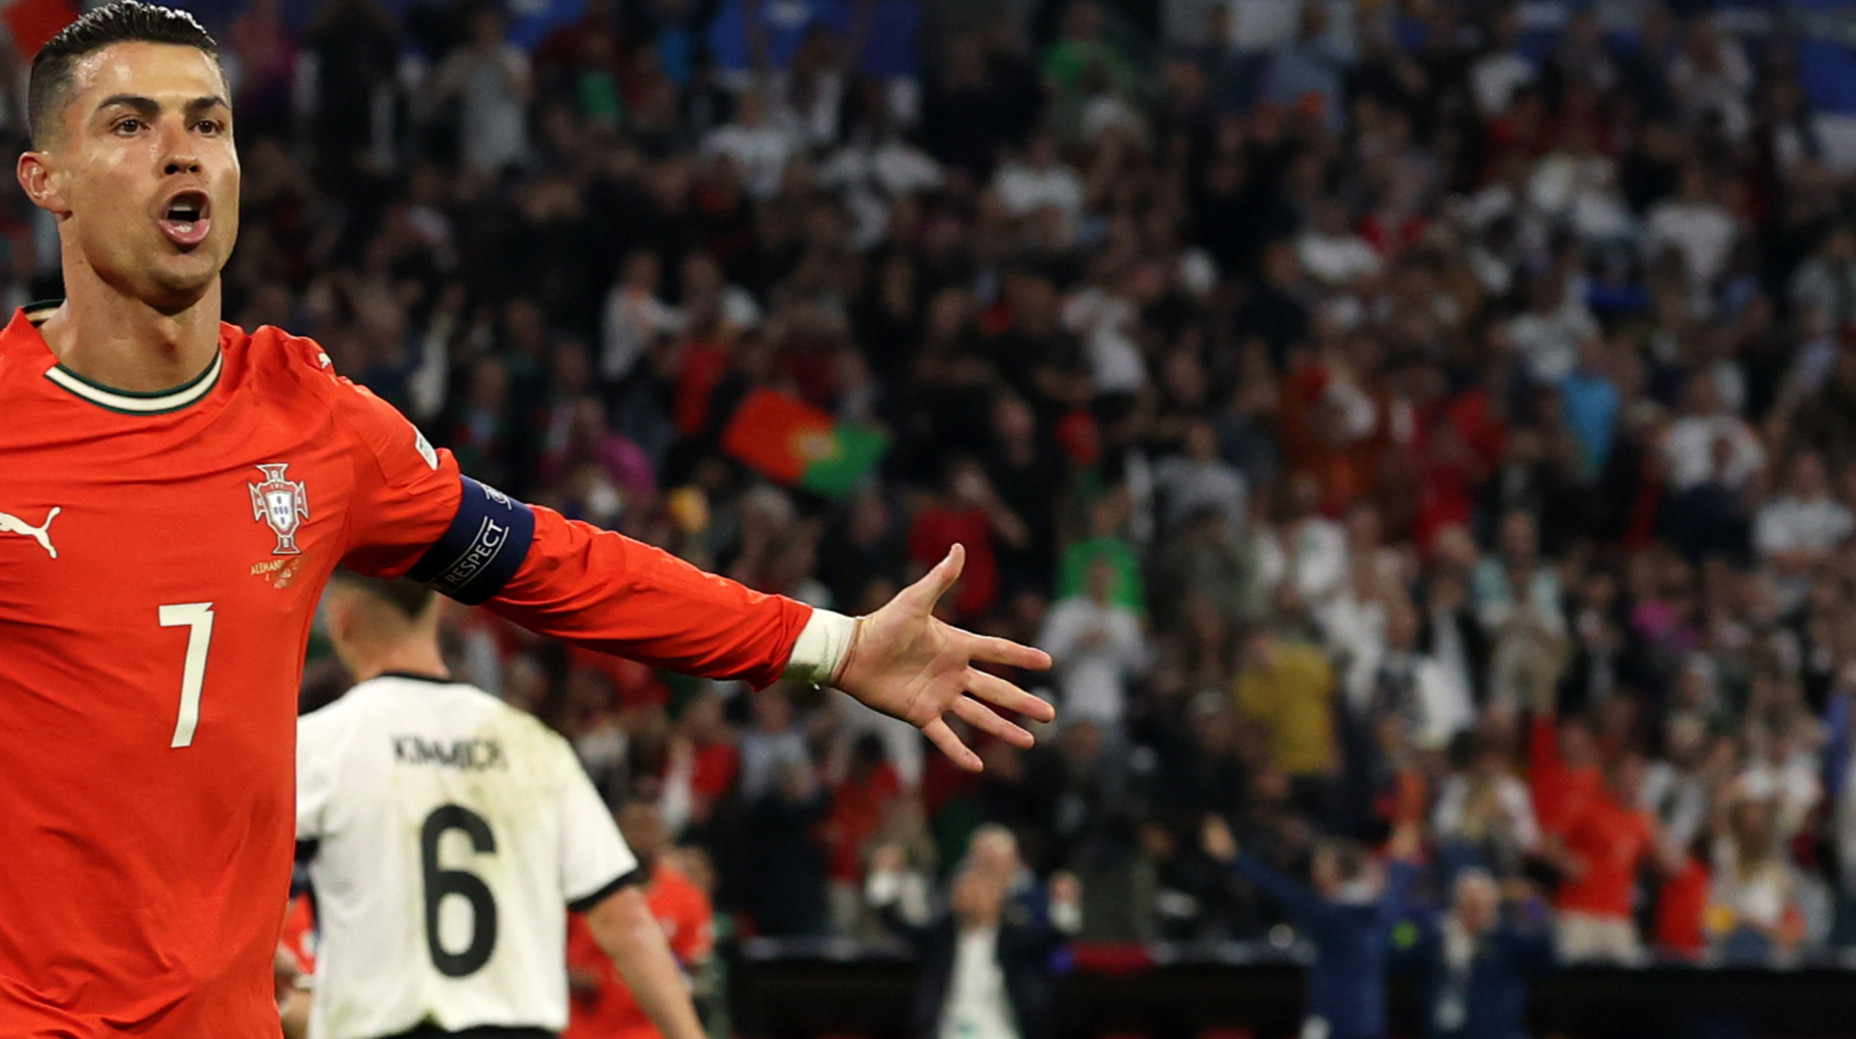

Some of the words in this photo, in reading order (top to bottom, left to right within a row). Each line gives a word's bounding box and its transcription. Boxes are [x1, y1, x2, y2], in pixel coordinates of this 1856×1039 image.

[445, 518, 504, 586] RESPECT
[158, 601, 215, 748] 7
[421, 804, 498, 978] 6
